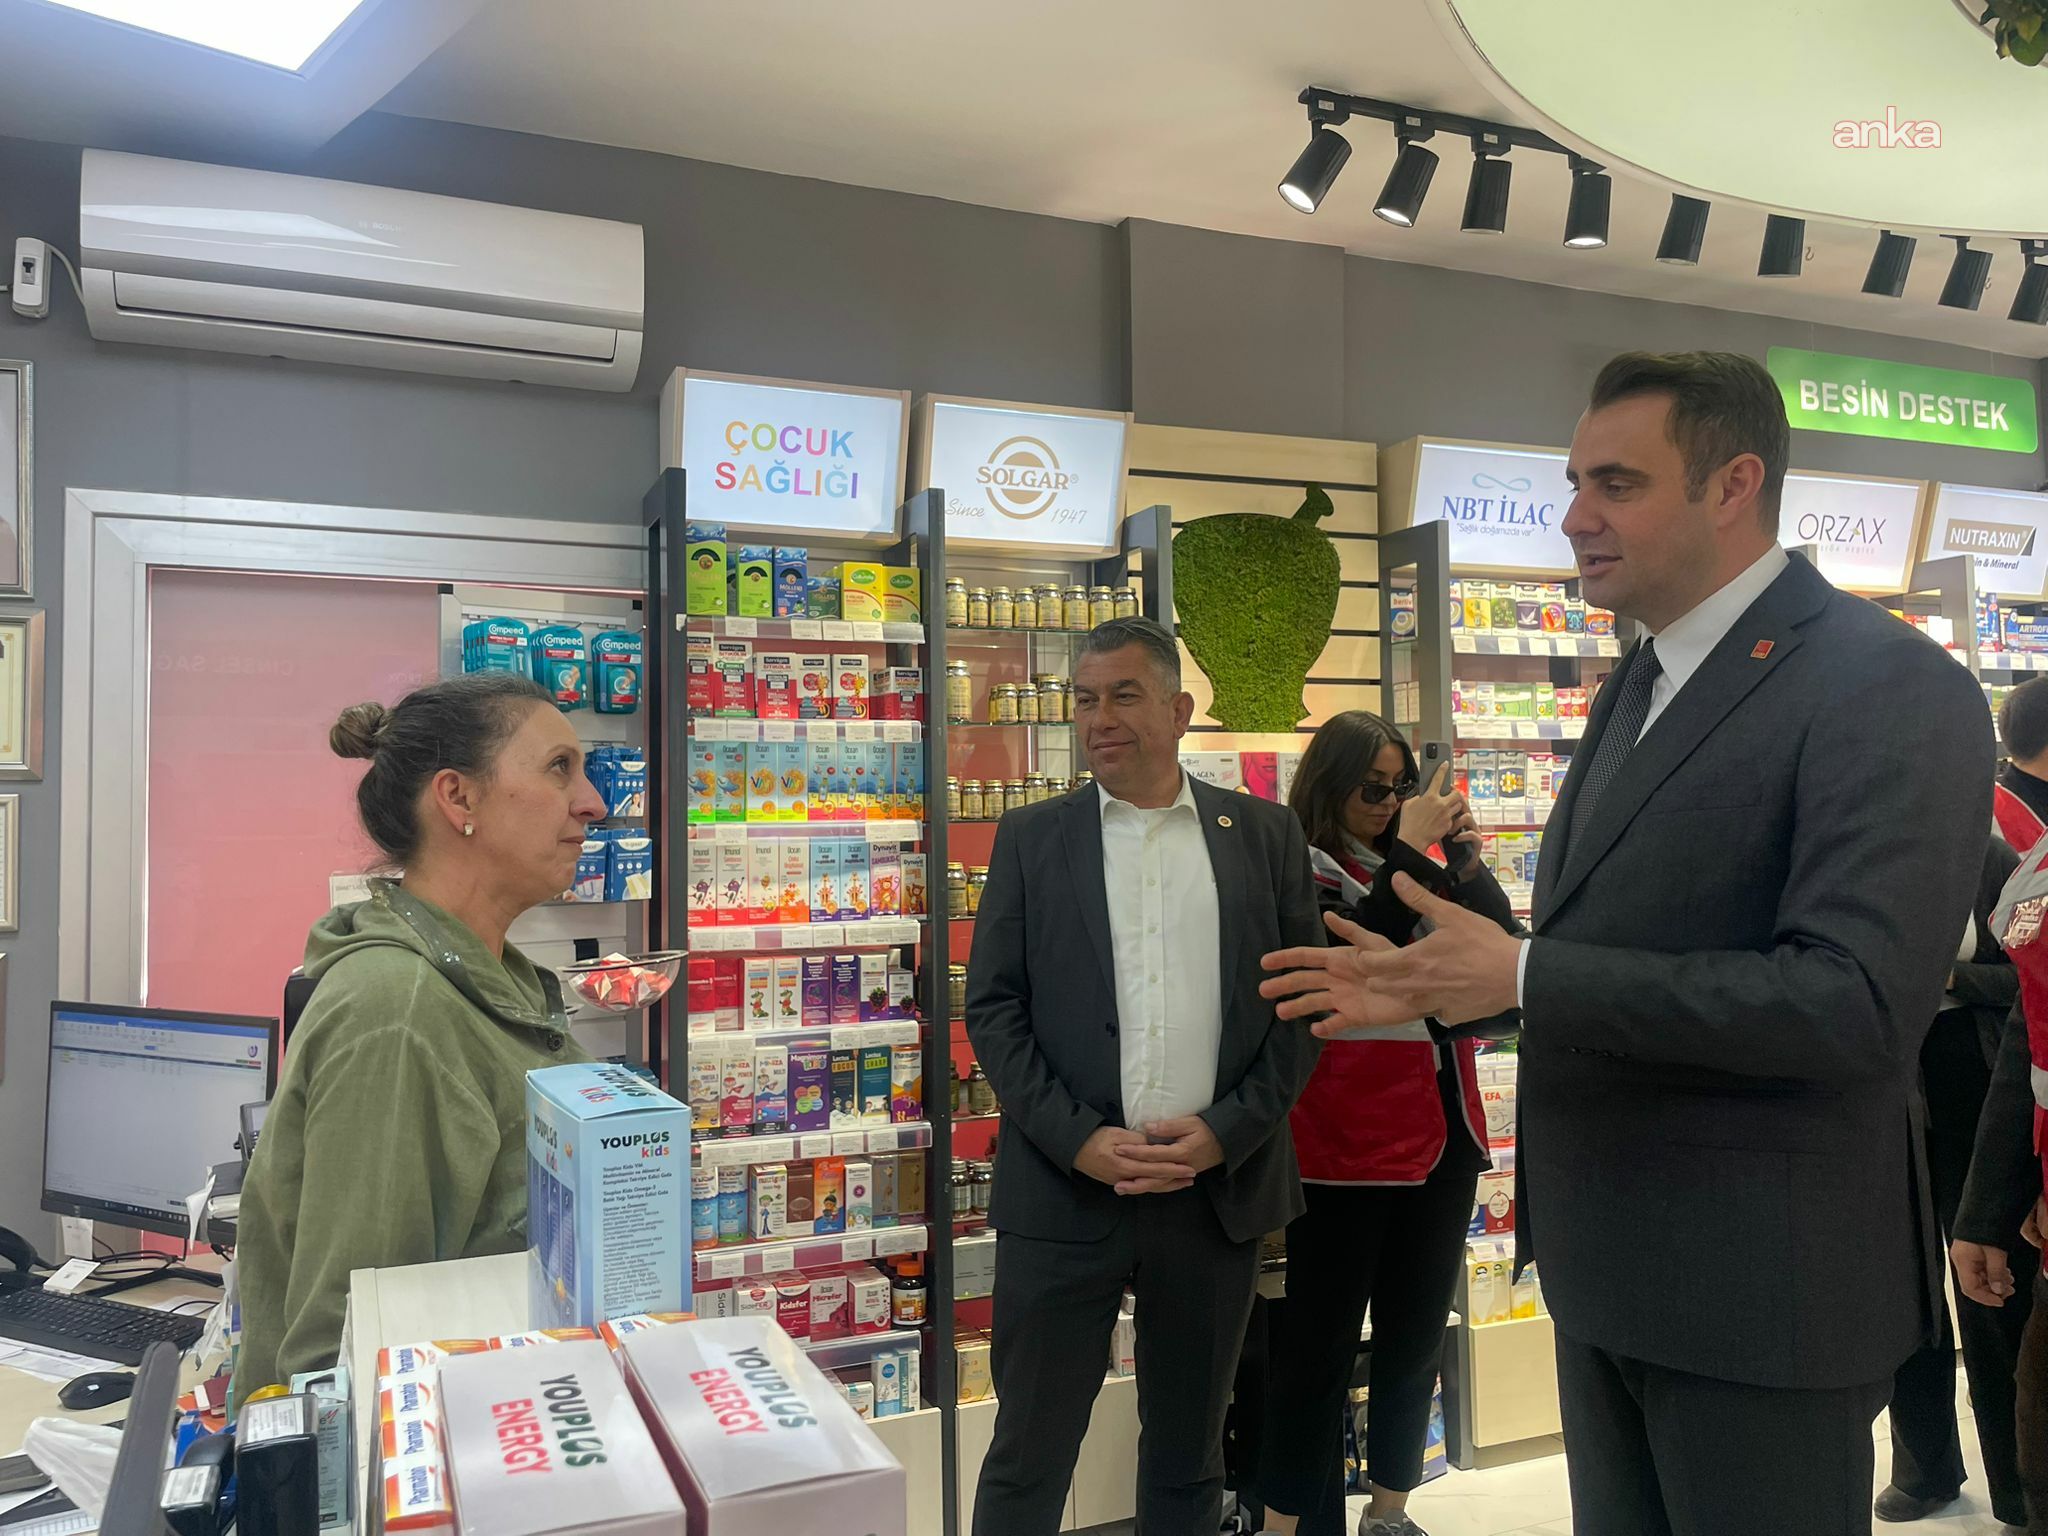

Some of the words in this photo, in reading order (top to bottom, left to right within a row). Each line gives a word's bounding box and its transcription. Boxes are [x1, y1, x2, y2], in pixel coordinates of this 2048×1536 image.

[1800, 379, 1889, 418] BESİN
[1899, 391, 2010, 431] DESTEK
[725, 420, 855, 458] ÇOCUK
[714, 460, 858, 499] SAĞLIĞI
[976, 466, 1069, 490] SOLGAR
[945, 498, 985, 517] Since
[1051, 508, 1088, 525] 1947
[1441, 496, 1494, 521] NBT
[1499, 495, 1554, 533] İLAÇ
[1798, 513, 1887, 544] ORZAX
[1949, 527, 2021, 549] NUTRAXIN
[1990, 559, 2020, 571] Mineral
[489, 624, 524, 636] Compeed
[544, 634, 583, 647] Compeed
[602, 638, 641, 652] Compeed
[873, 844, 898, 853] Dynavit
[1484, 1091, 1501, 1101] EFA
[600, 1131, 670, 1150] YOUPLUS
[642, 1146, 670, 1158] kids
[780, 1300, 808, 1310] Kidsfer
[396, 1347, 415, 1374] Pharmaton
[399, 1382, 419, 1412] Pharmaton
[689, 1368, 769, 1435] ENERGY
[403, 1419, 424, 1455] Pharmaton
[492, 1398, 553, 1475] ENERGY
[407, 1464, 430, 1506] Pharmaton
